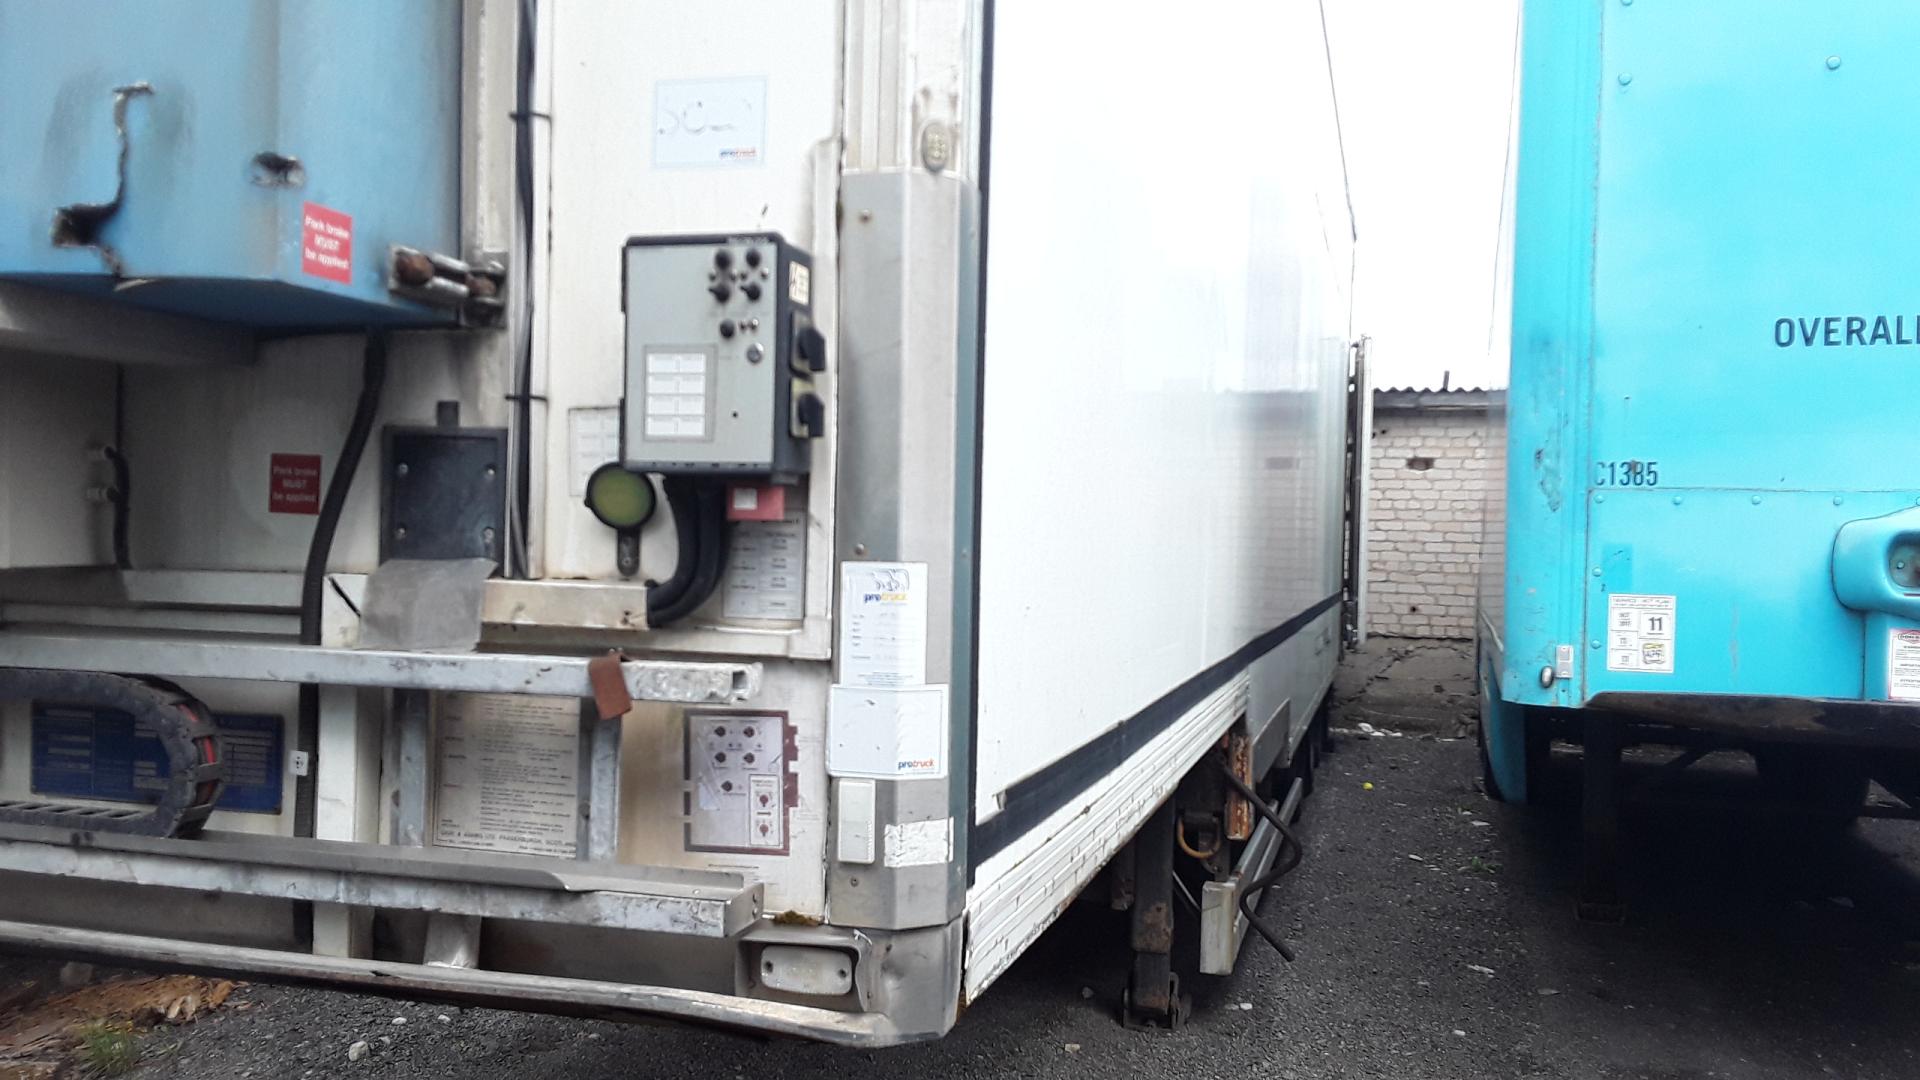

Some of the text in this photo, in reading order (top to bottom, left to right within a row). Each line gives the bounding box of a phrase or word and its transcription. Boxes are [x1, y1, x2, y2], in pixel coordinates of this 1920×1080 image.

[305, 215, 349, 240] Park brake
[314, 233, 339, 250] MUST
[305, 247, 349, 270] be applied
[1774, 315, 1920, 348] OVERAL
[1648, 616, 1663, 631] 11
[898, 758, 934, 770] protruck
